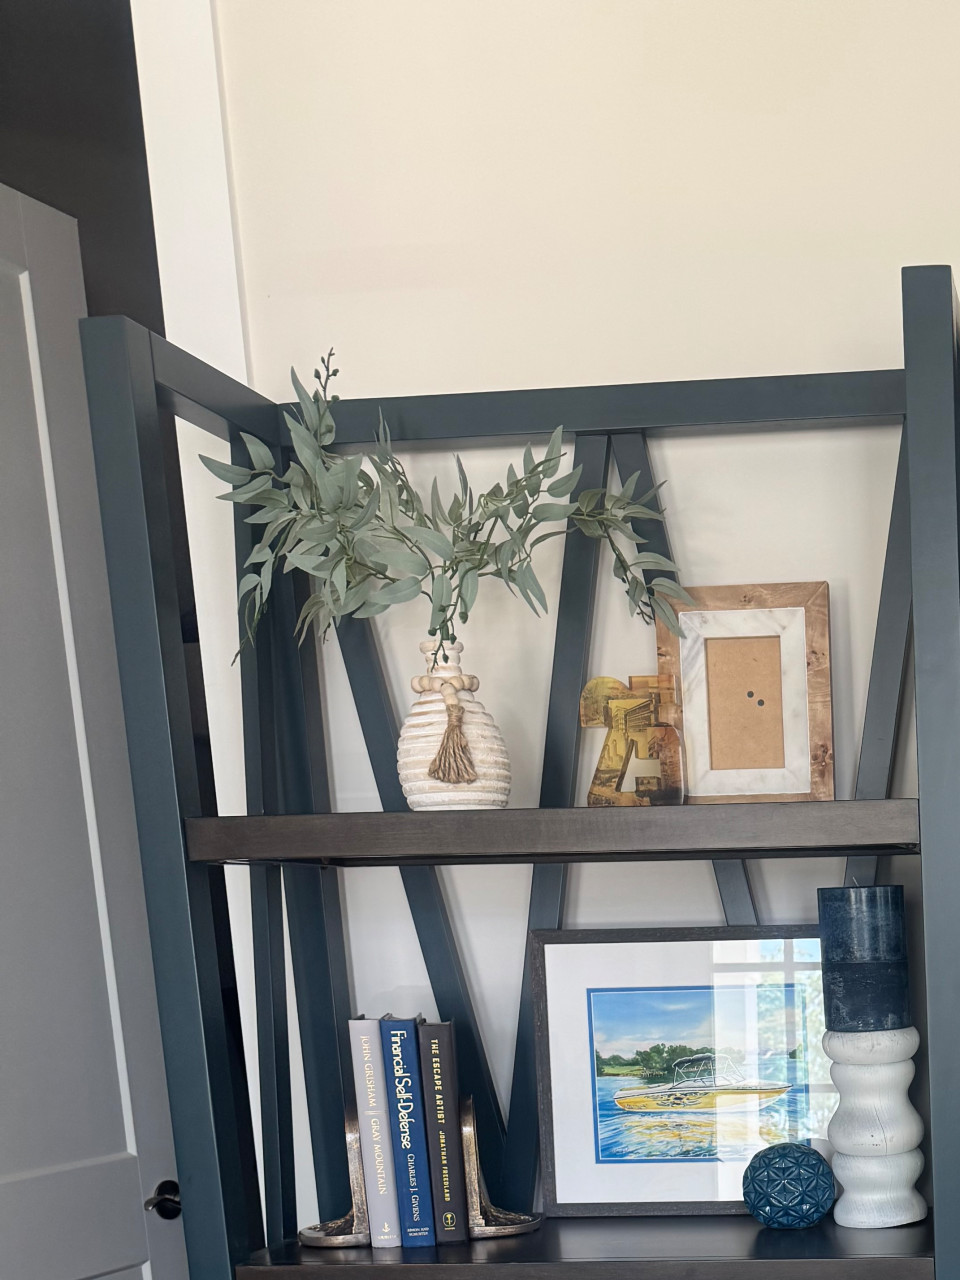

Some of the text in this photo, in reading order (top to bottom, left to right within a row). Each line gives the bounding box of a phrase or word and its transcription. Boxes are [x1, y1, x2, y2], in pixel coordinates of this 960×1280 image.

[360, 1035, 376, 1106] JOHN GRISHAM
[390, 1030, 415, 1149] Financial Self-Defense
[430, 1038, 446, 1124] THE ESCAPE ARTIST
[371, 1118, 387, 1195] GRAY MOUNTAIN
[407, 1154, 417, 1186] CHARLES
[412, 1194, 420, 1222] GIVENS
[439, 1130, 451, 1202] JONATHAN FREEDLAND
